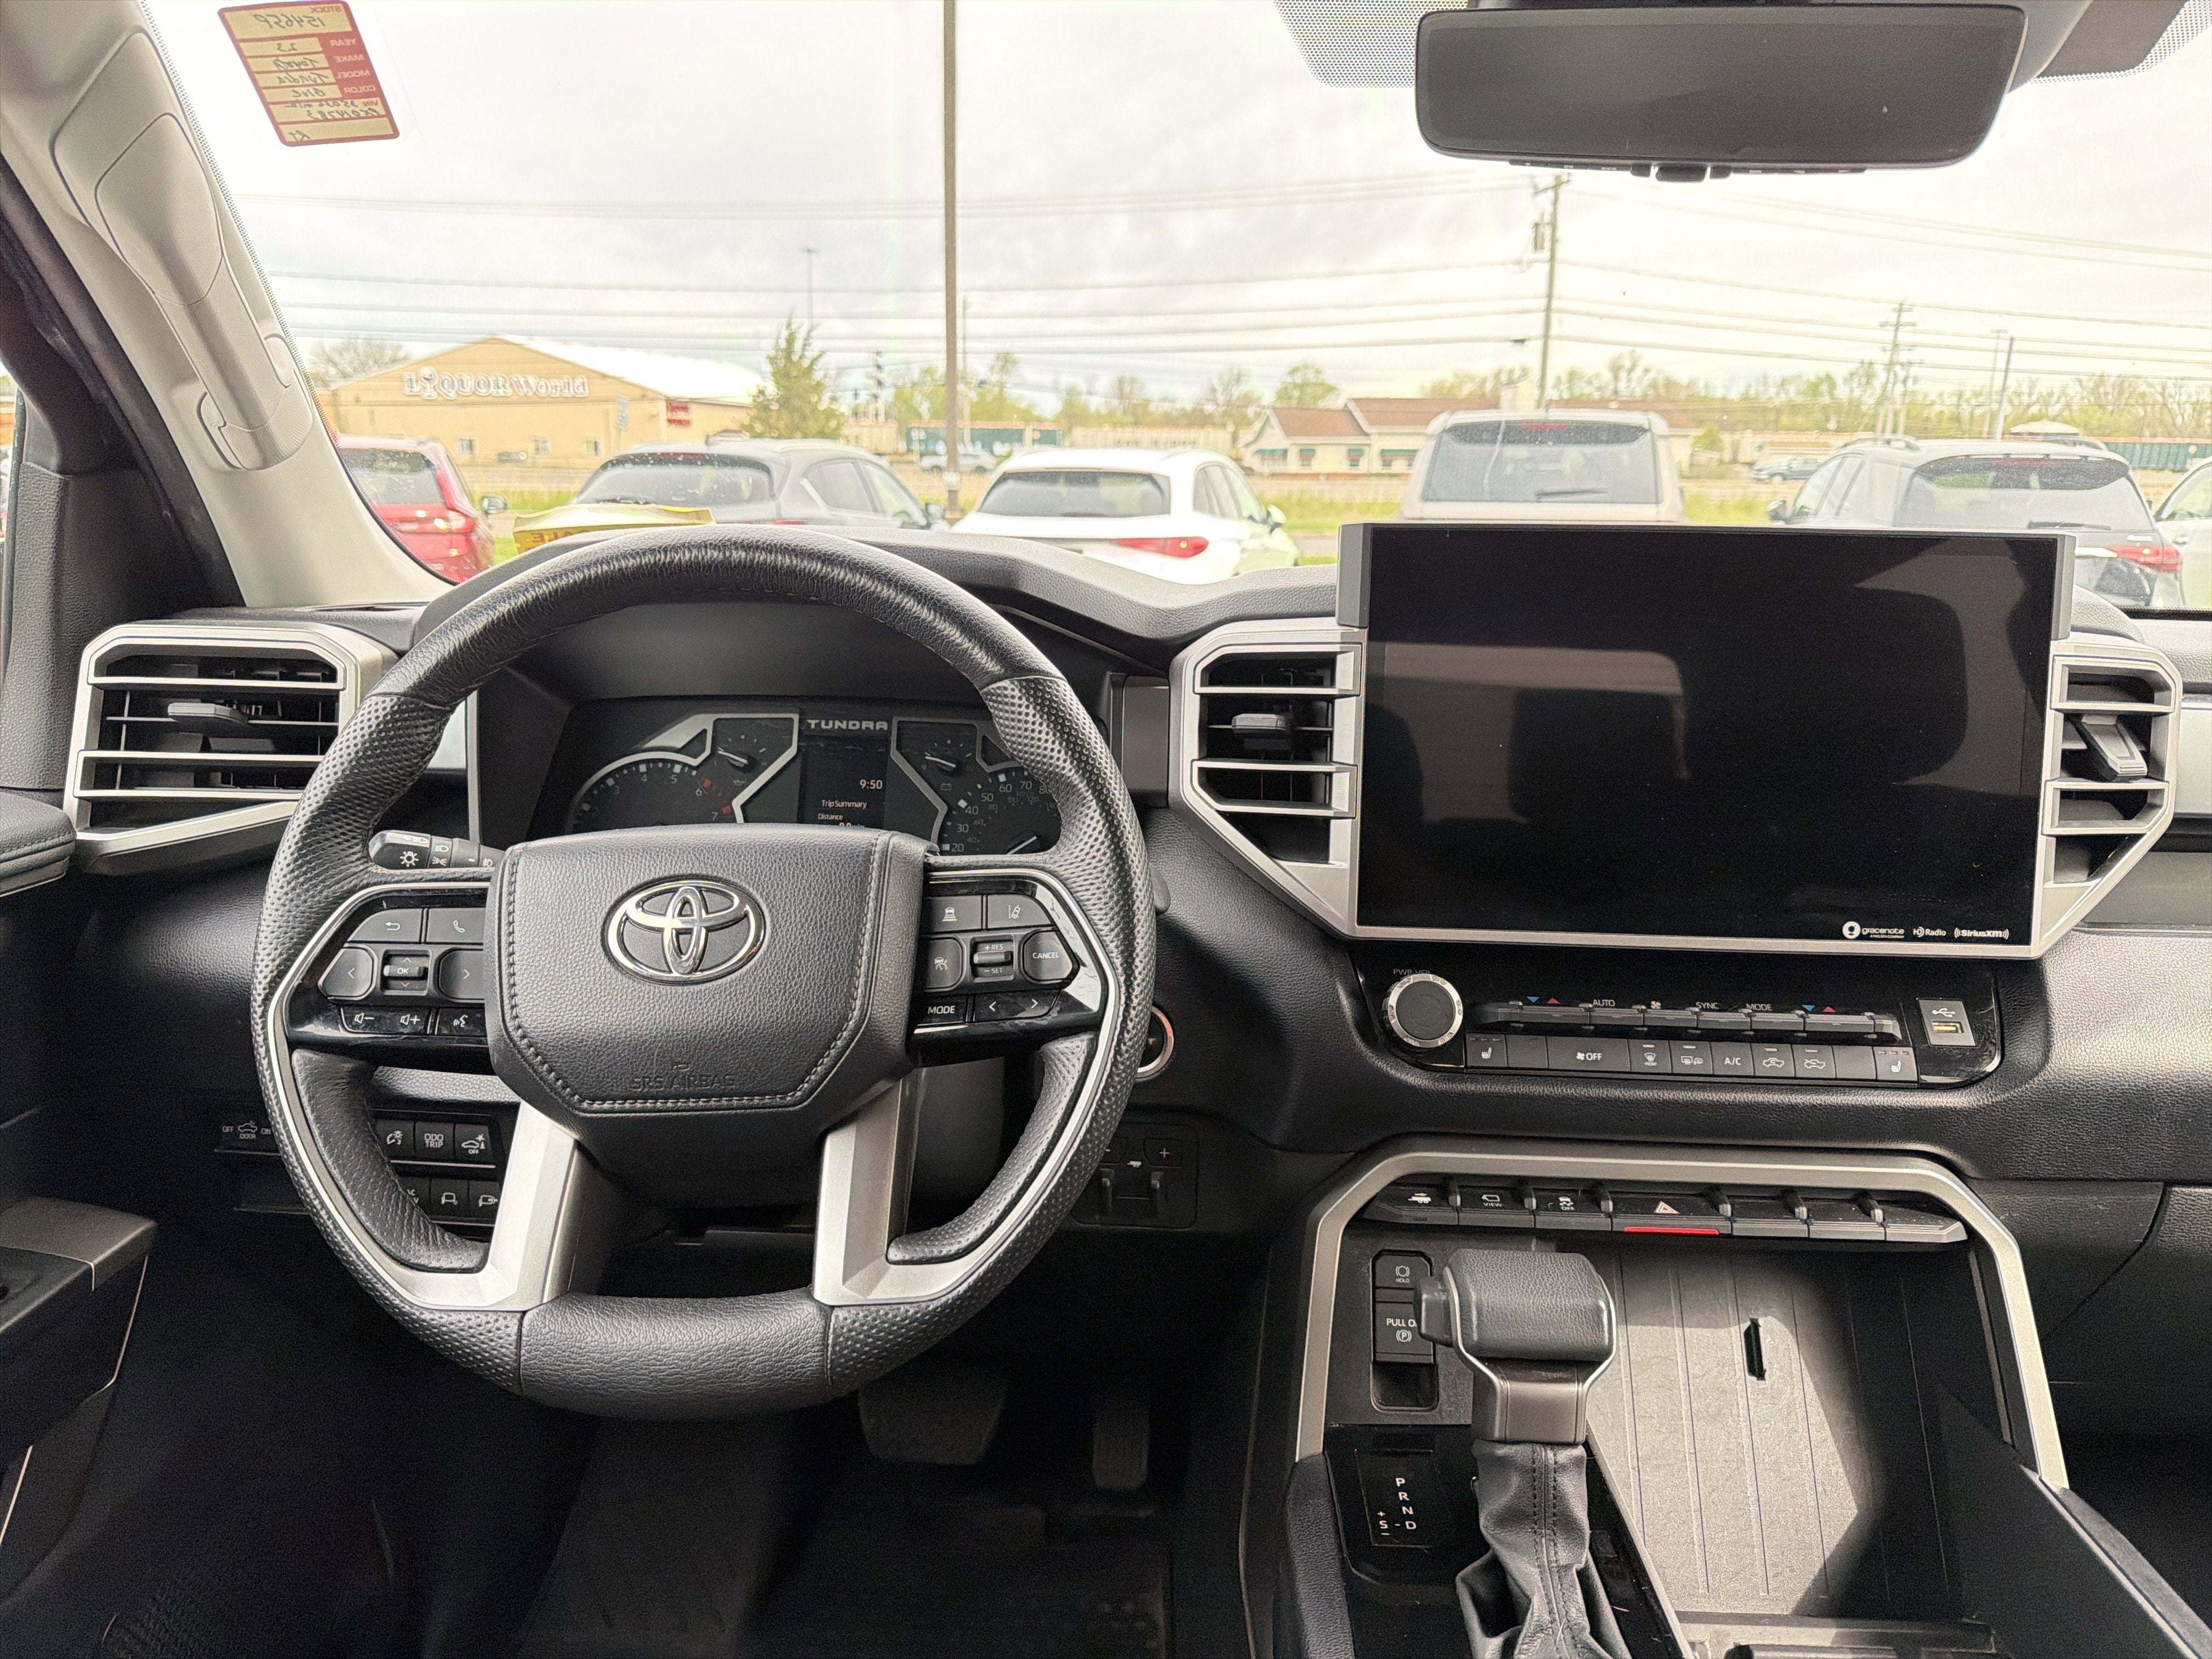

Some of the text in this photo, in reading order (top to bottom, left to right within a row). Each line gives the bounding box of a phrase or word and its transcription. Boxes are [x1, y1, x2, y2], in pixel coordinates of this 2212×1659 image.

[513, 375, 589, 397] World
[806, 720, 888, 730] TUNDRA
[641, 774, 648, 782] 4
[670, 775, 677, 783] 5
[860, 780, 883, 789] 9:50
[999, 784, 1012, 793] 60
[1020, 781, 1032, 789] 70
[695, 788, 703, 796] 6
[981, 793, 994, 802] 50
[822, 799, 867, 809] Trip Summary
[965, 806, 979, 815] 40
[712, 812, 718, 820] 7
[957, 824, 969, 833] 30
[951, 843, 964, 852] 20
[1925, 928, 1946, 936] Radio
[928, 1005, 955, 1014] MODE
[1724, 1057, 1742, 1065] A/C
[424, 1133, 444, 1141] ODO
[1386, 1318, 1417, 1327] PULL O
[1395, 1477, 1406, 1487] P
[1398, 1492, 1410, 1501] R
[1402, 1506, 1414, 1515] N
[1379, 1520, 1417, 1530] S D
